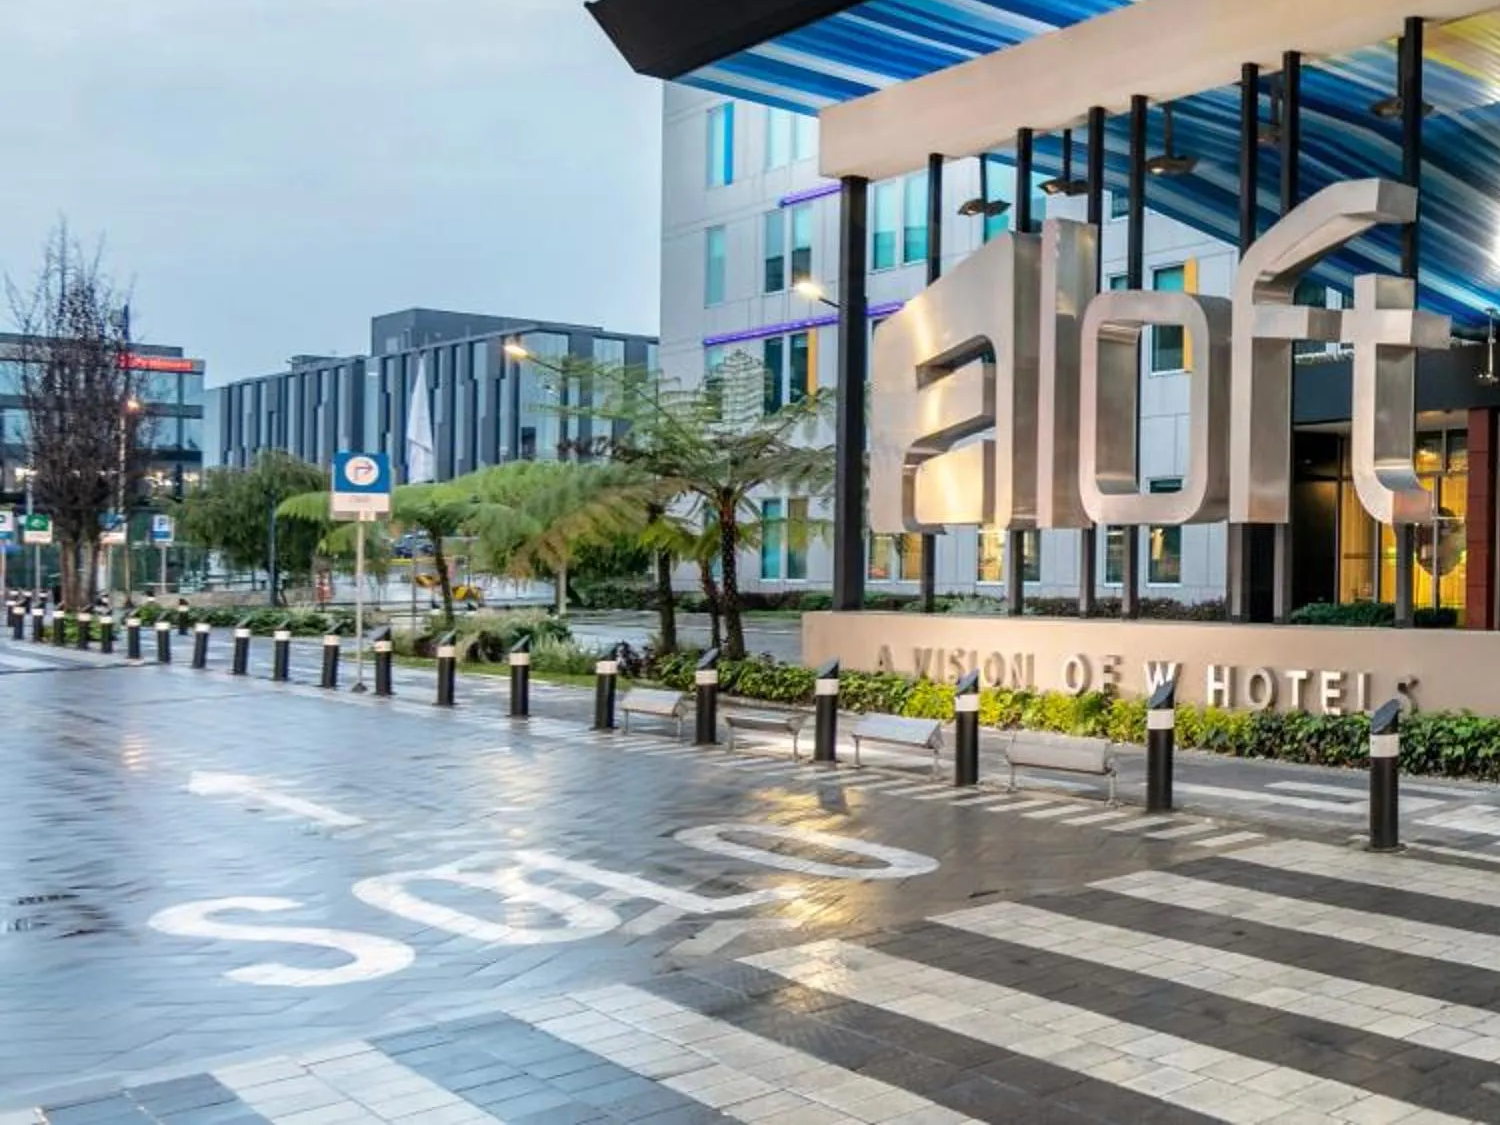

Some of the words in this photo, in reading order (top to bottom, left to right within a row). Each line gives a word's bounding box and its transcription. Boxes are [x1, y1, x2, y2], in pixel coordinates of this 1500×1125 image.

[869, 178, 1452, 535] aloft
[877, 644, 897, 674] A
[912, 647, 1035, 689] VISION
[1063, 652, 1122, 698] OF
[1144, 660, 1182, 704] W
[147, 822, 941, 987] SOLO
